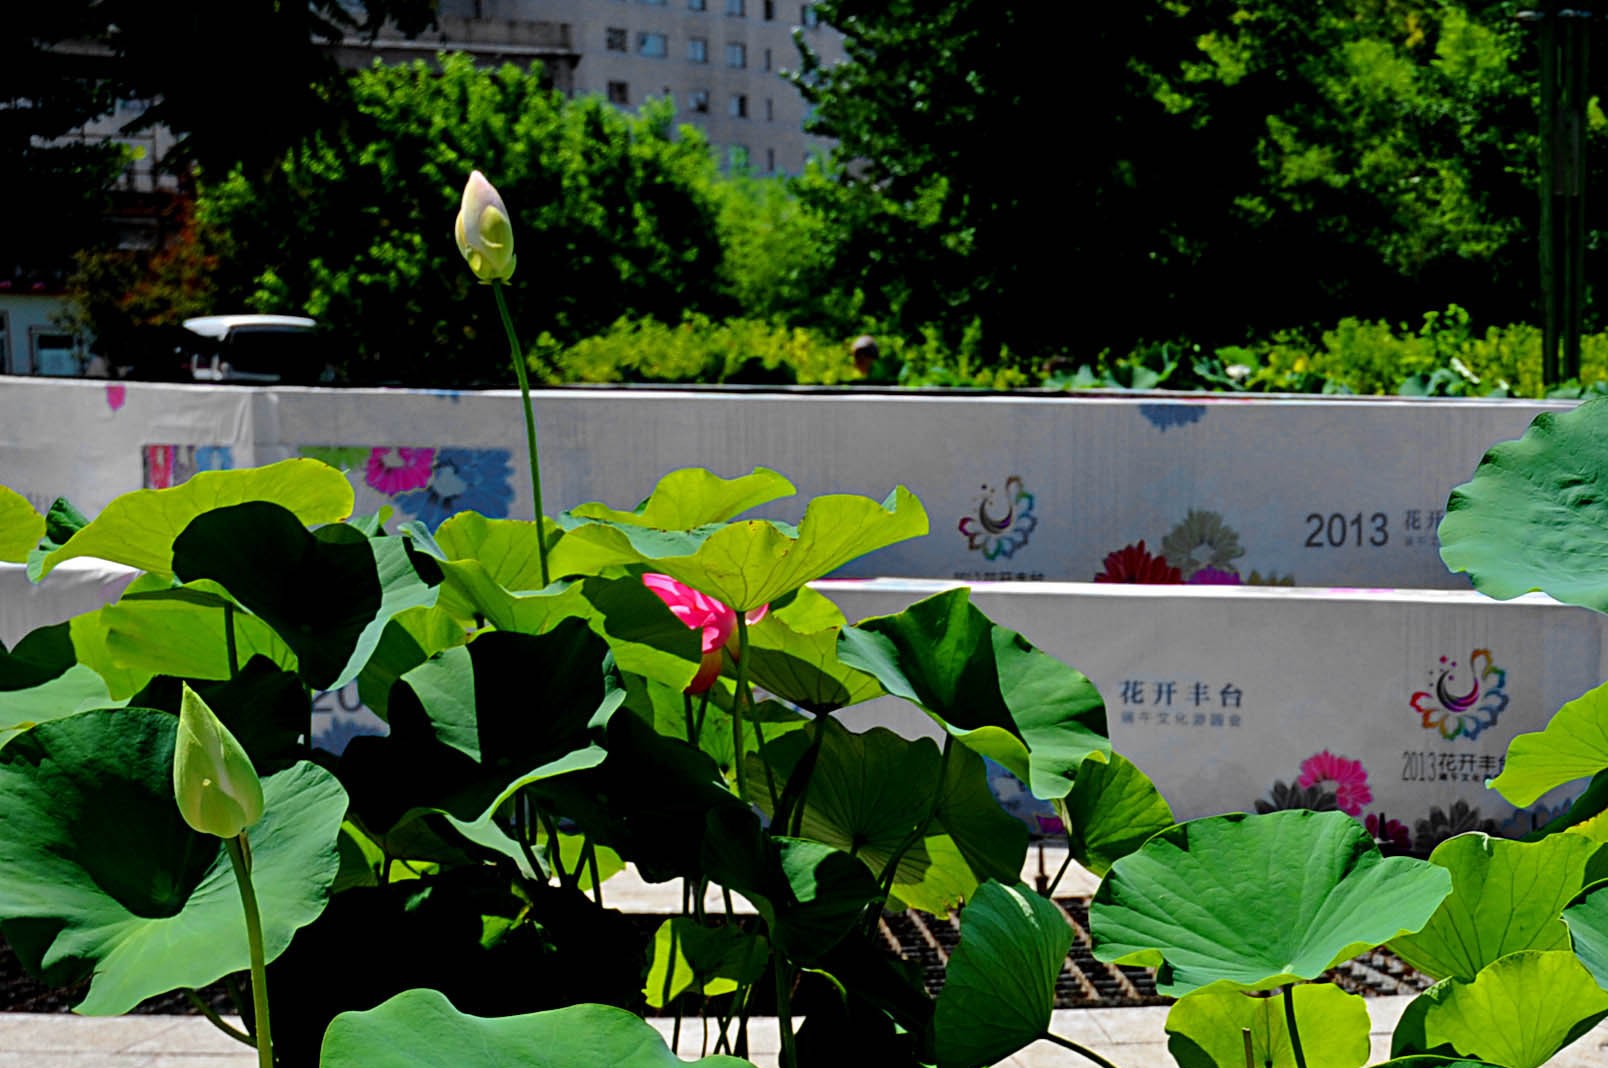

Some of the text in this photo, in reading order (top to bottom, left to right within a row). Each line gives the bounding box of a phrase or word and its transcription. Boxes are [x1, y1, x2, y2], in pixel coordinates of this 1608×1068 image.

[1305, 512, 1389, 547] 2013
[1120, 680, 1243, 708] 花开丰台
